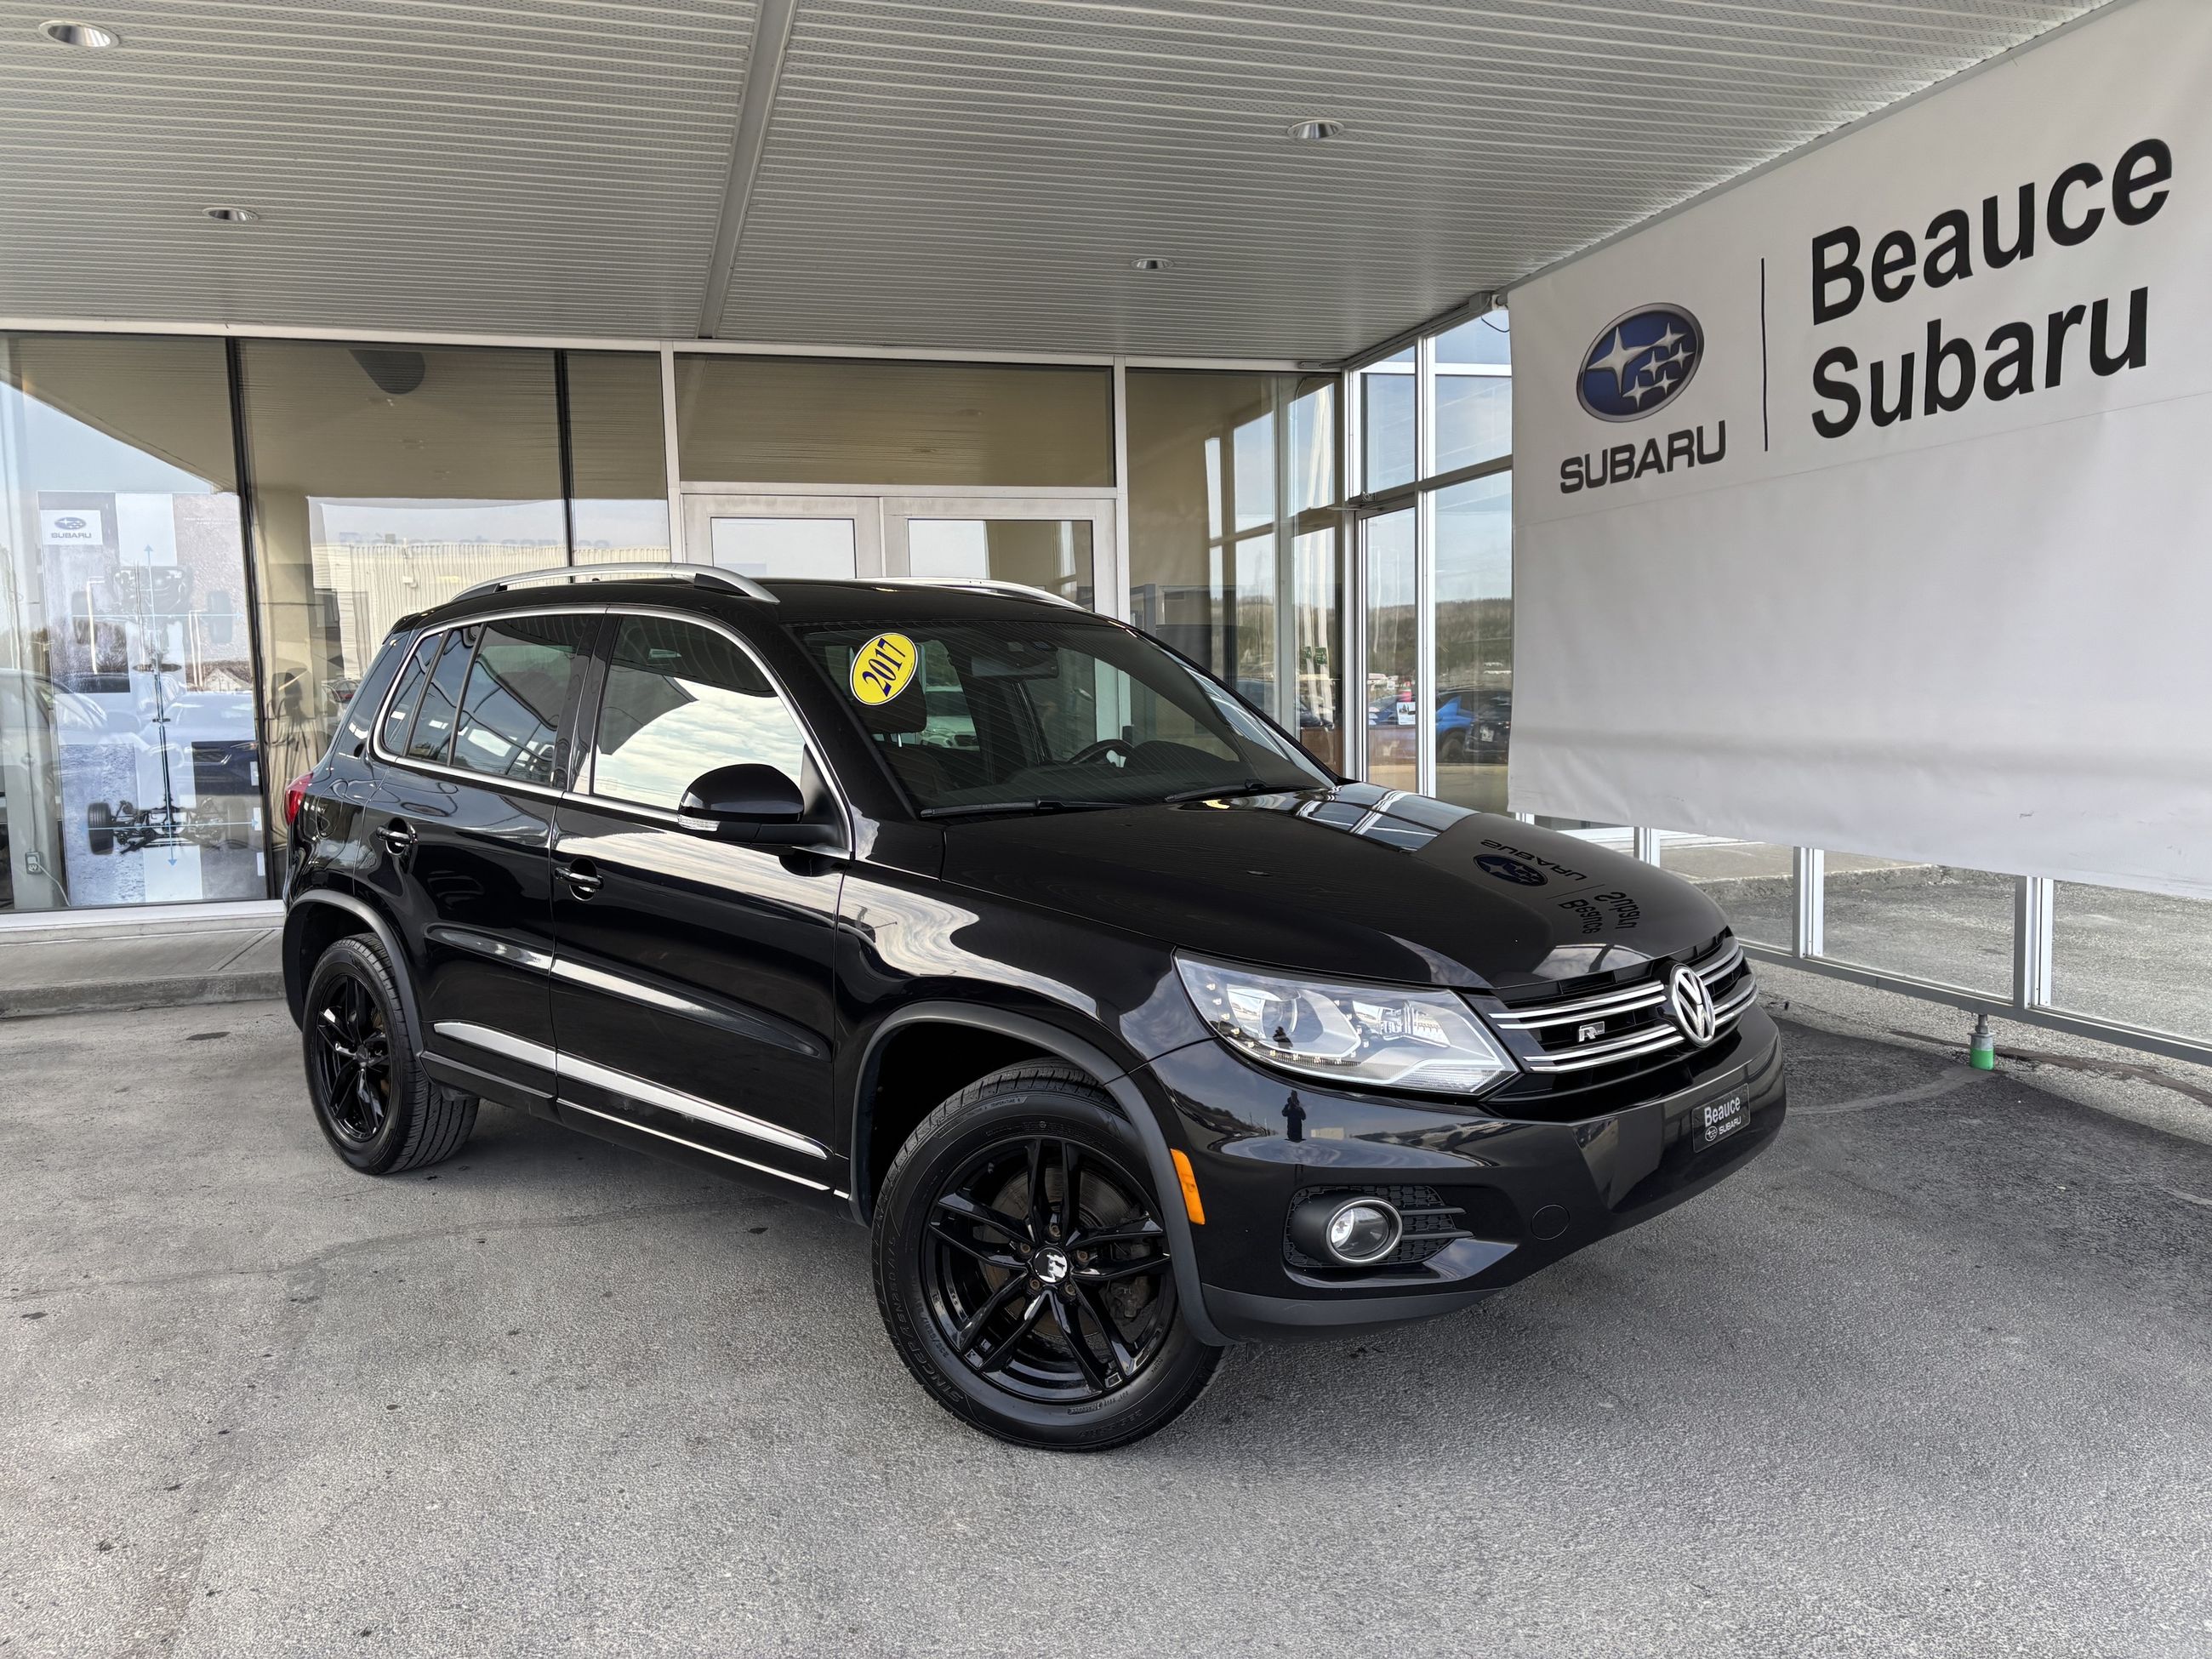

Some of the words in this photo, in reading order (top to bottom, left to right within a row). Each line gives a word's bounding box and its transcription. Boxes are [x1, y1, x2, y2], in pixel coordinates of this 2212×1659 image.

[1812, 139, 2173, 325] Beauce
[1812, 287, 2149, 439] Subaru
[1560, 420, 1726, 493] SUBARU
[863, 638, 906, 697] 2017
[1704, 1097, 1741, 1127] Beauce
[1719, 1115, 1742, 1135] SUBARU
